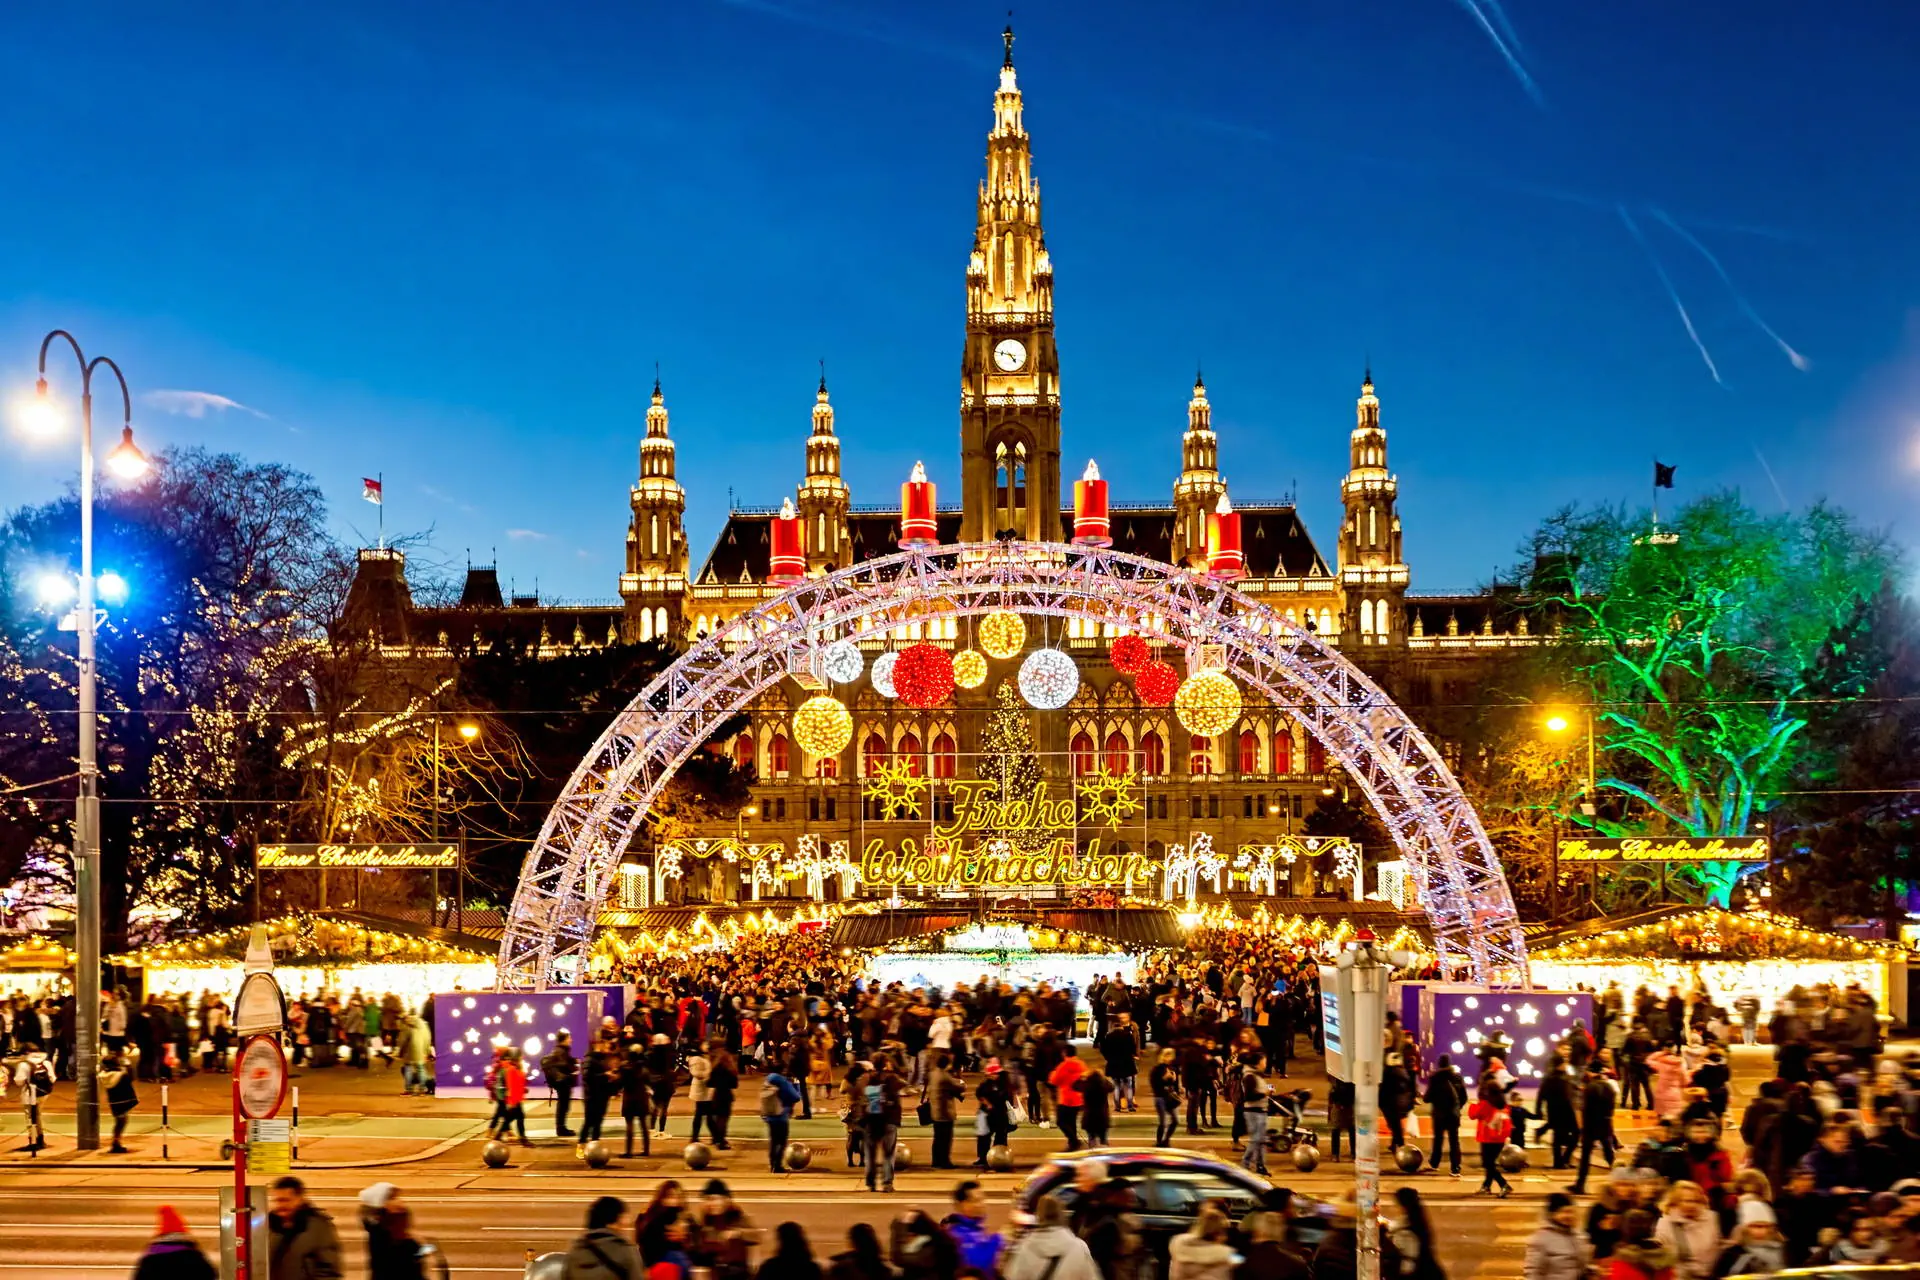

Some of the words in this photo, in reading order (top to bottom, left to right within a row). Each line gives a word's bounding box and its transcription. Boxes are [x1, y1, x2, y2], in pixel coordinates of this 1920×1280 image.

[934, 780, 1077, 837] Frohe
[258, 846, 316, 867] Wiener
[317, 844, 457, 866] Christkindlmarkt
[862, 837, 1148, 885] Weihnachten
[1558, 839, 1619, 860] Wiener
[1620, 838, 1768, 860] Christkindlmarkt
